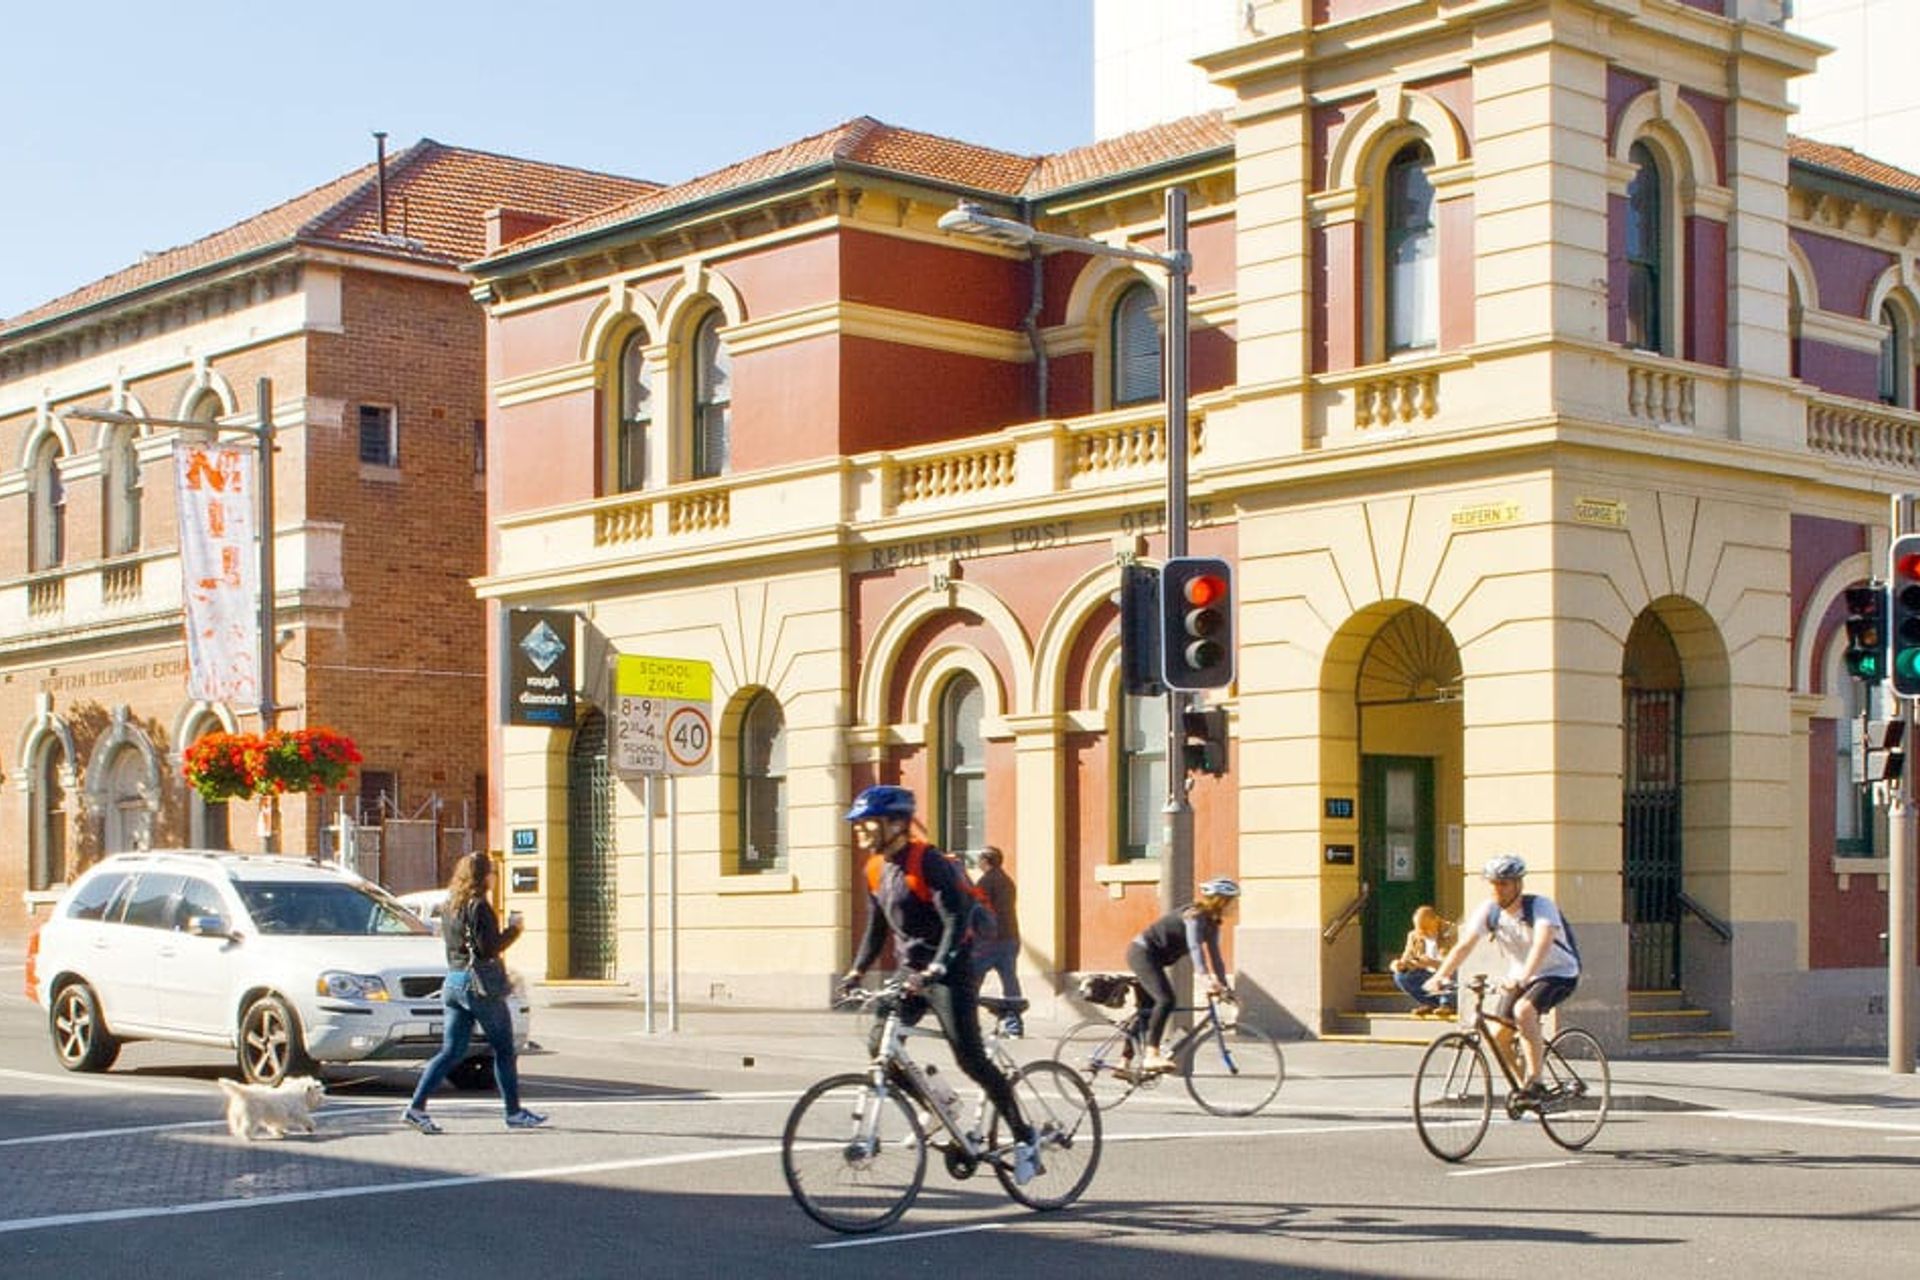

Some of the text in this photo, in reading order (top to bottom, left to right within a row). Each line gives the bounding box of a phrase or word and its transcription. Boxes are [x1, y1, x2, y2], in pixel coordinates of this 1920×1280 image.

[1451, 509, 1501, 524] REDFERN
[873, 502, 1213, 569] REDFERN POST OFFCE
[152, 658, 189, 679] EXCHA
[640, 661, 690, 678] SCHOOL
[526, 674, 560, 689] rough
[648, 679, 685, 694] ZONE
[519, 691, 569, 706] diamond
[674, 724, 705, 750] 40
[623, 742, 660, 756] SCHOOL
[629, 755, 654, 767] DAYS
